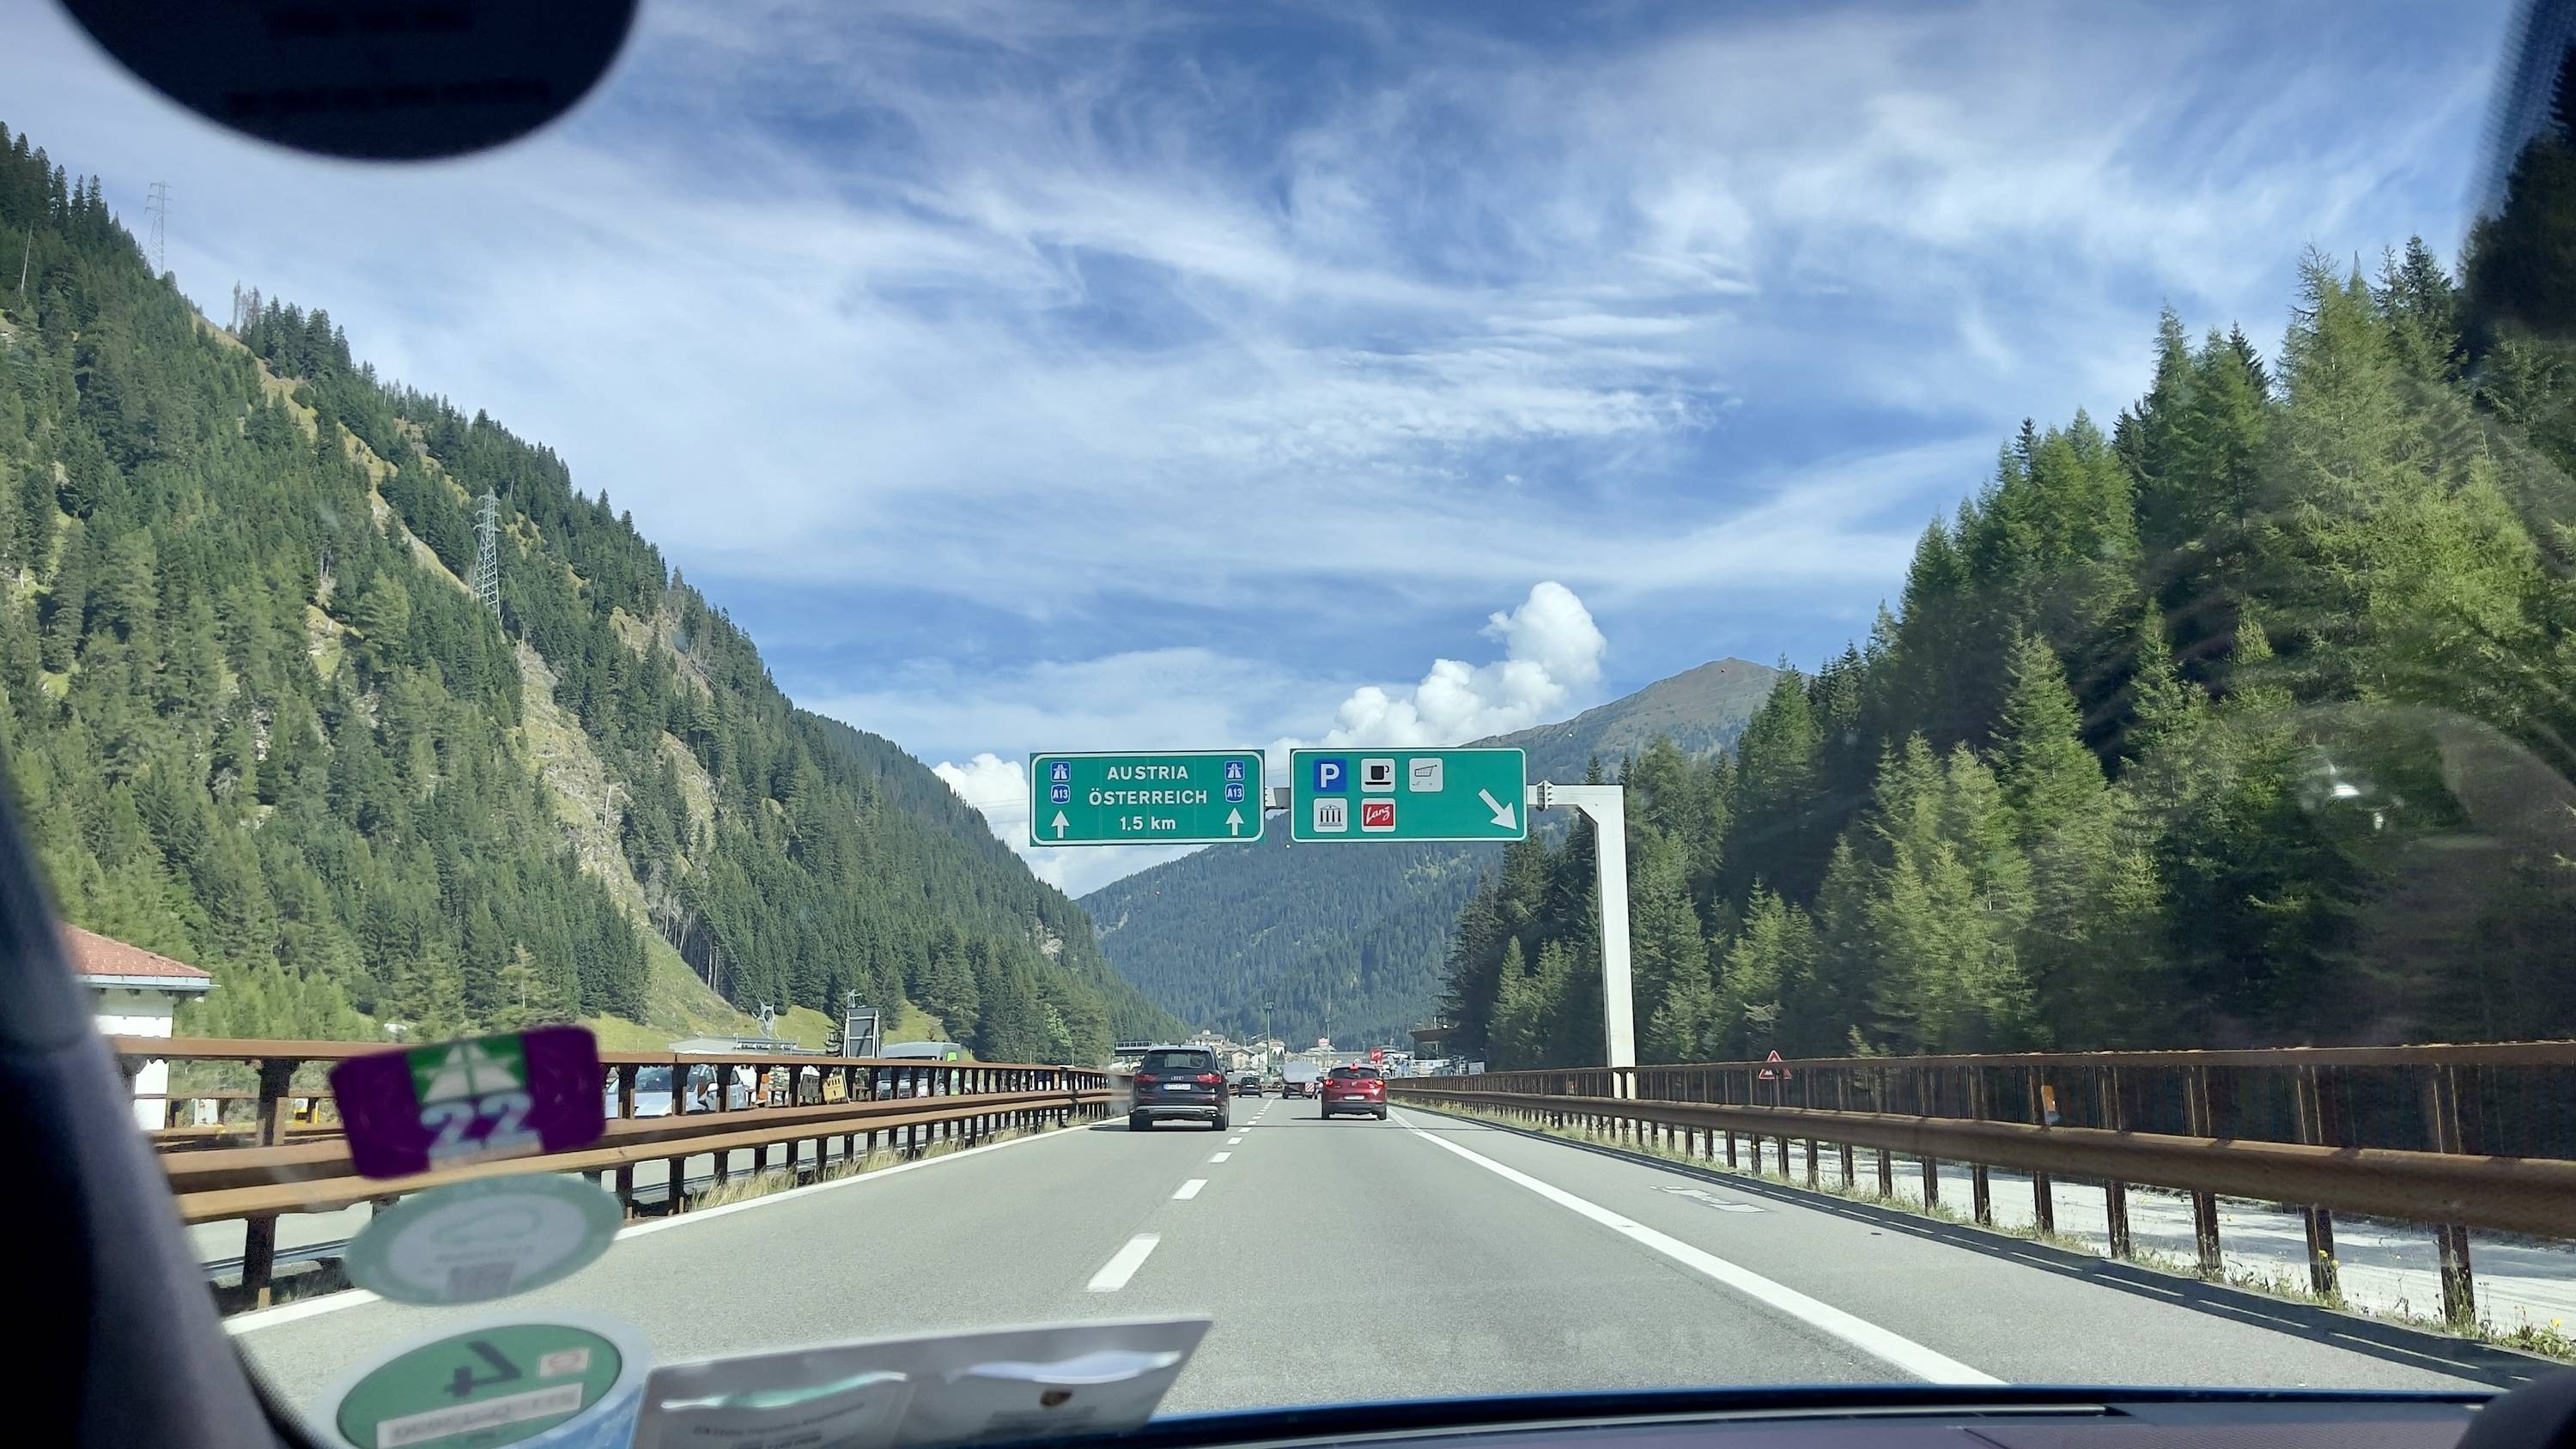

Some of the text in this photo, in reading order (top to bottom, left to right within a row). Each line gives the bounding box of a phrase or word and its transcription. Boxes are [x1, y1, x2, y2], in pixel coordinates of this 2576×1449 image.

[1107, 765, 1189, 780] AUSTRIA
[1320, 763, 1340, 788] P
[1053, 789, 1068, 799] A13
[1088, 787, 1207, 805] ÖSTERREICH
[1226, 788, 1242, 798] A13
[1151, 815, 1176, 830] km
[1365, 805, 1391, 825] Lanz
[420, 1092, 543, 1159] 22
